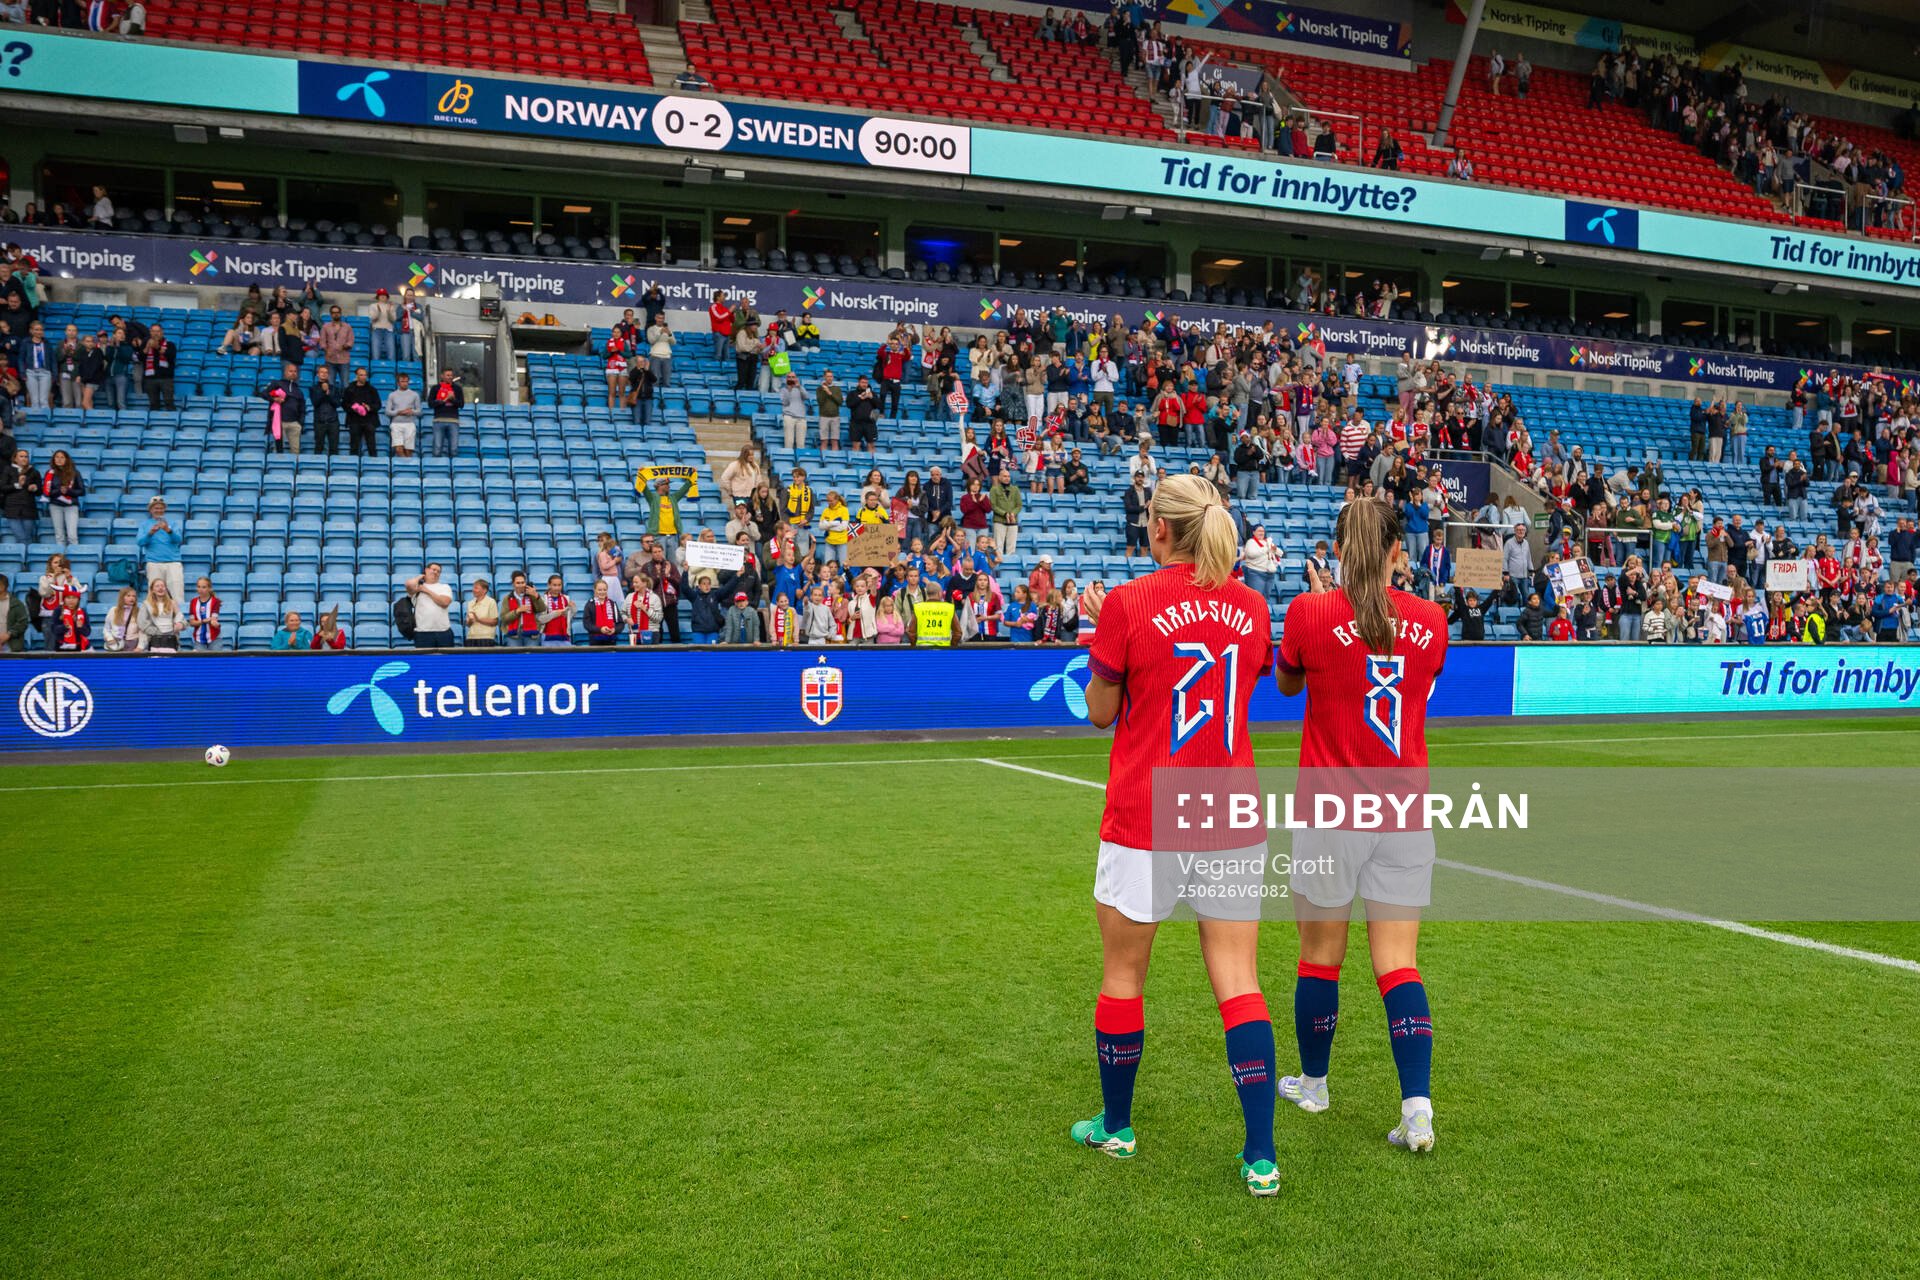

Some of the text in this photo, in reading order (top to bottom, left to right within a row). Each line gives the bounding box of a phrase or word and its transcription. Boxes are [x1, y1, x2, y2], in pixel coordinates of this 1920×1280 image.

[1300, 17, 1388, 48] Norsk Tipping
[1491, 9, 1566, 35] Norsk Tipping
[1756, 60, 1819, 86] Norsk Tipping
[434, 114, 478, 125] BREITLING
[504, 95, 648, 132] NORWAY
[737, 118, 855, 151] SWEDEN
[874, 130, 957, 160] 90:00
[1160, 157, 1417, 213] Tid for innbytte?
[56, 246, 135, 273] Tipping
[1770, 236, 1805, 262] Tid
[1810, 240, 1844, 268] for
[225, 256, 358, 284] Norsk Tipping
[441, 268, 565, 296] Norsk Tipping
[830, 292, 939, 318] Norsk Tipping
[1320, 328, 1406, 351] Norsk Tipping
[1460, 339, 1539, 363] Norsk Tipping
[1589, 351, 1662, 374] Norsk Tipping
[1707, 362, 1775, 384] Norsk Tipping
[651, 467, 694, 478] SWEDEN
[1773, 561, 1798, 574] FRIDA
[926, 619, 943, 628] 204
[1751, 620, 1767, 637] 11
[1721, 659, 1920, 699] Tid for innby
[414, 675, 599, 718] telenor
[1170, 642, 1239, 757] 21
[1364, 654, 1404, 759] 8
